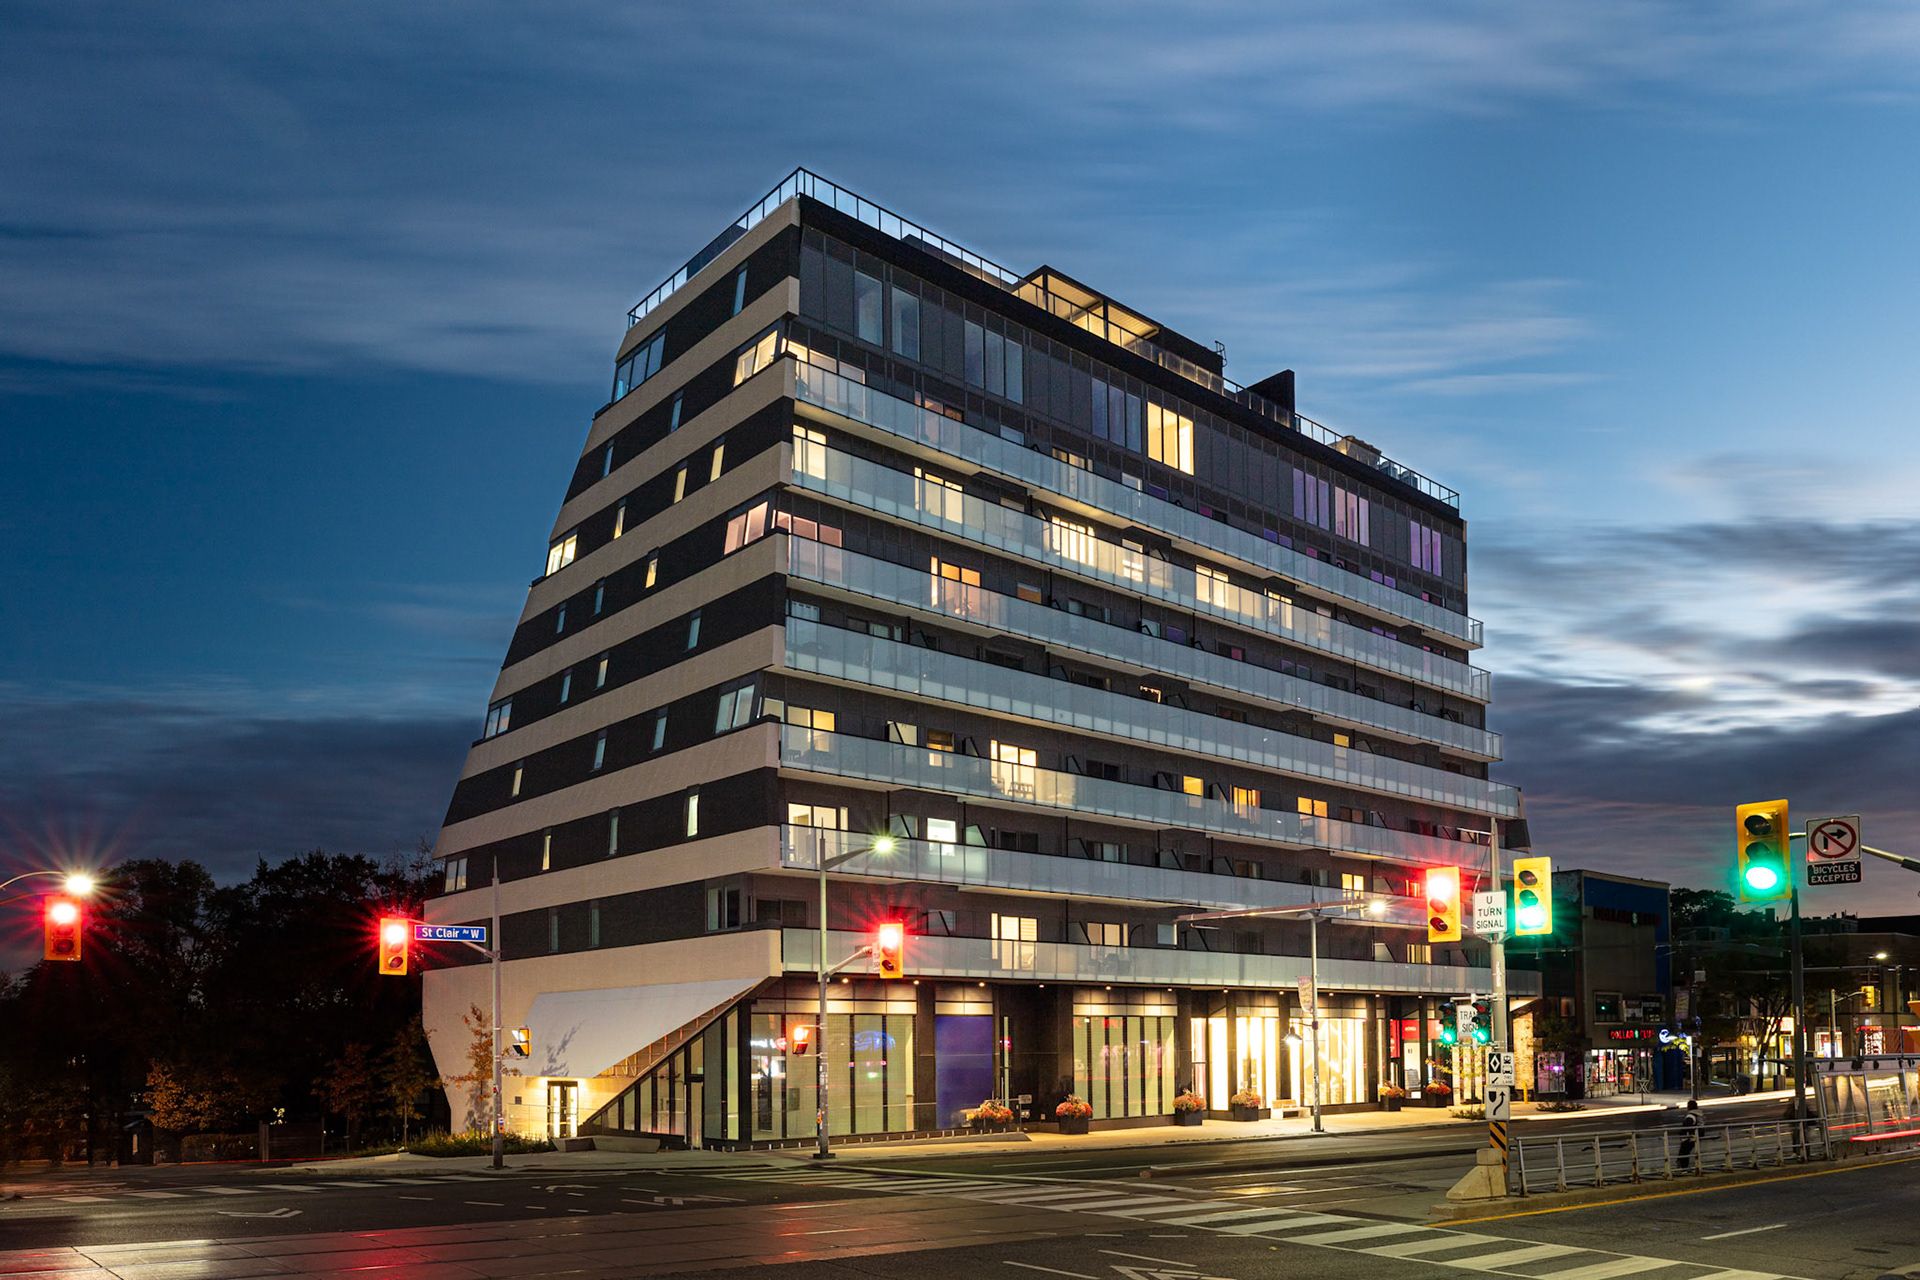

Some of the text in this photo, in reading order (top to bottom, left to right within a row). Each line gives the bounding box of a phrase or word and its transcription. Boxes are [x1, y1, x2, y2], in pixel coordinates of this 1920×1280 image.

[1813, 864, 1855, 874] BICYCLES
[1811, 873, 1858, 883] EXCEPTED
[1486, 896, 1492, 904] U
[1478, 908, 1502, 917] TURN
[1476, 920, 1504, 929] SIGNAL
[422, 928, 432, 937] St
[436, 928, 459, 938] Clair
[471, 929, 479, 938] W
[1462, 1023, 1478, 1033] SIGN
[1610, 1030, 1634, 1039] DOLLAR
